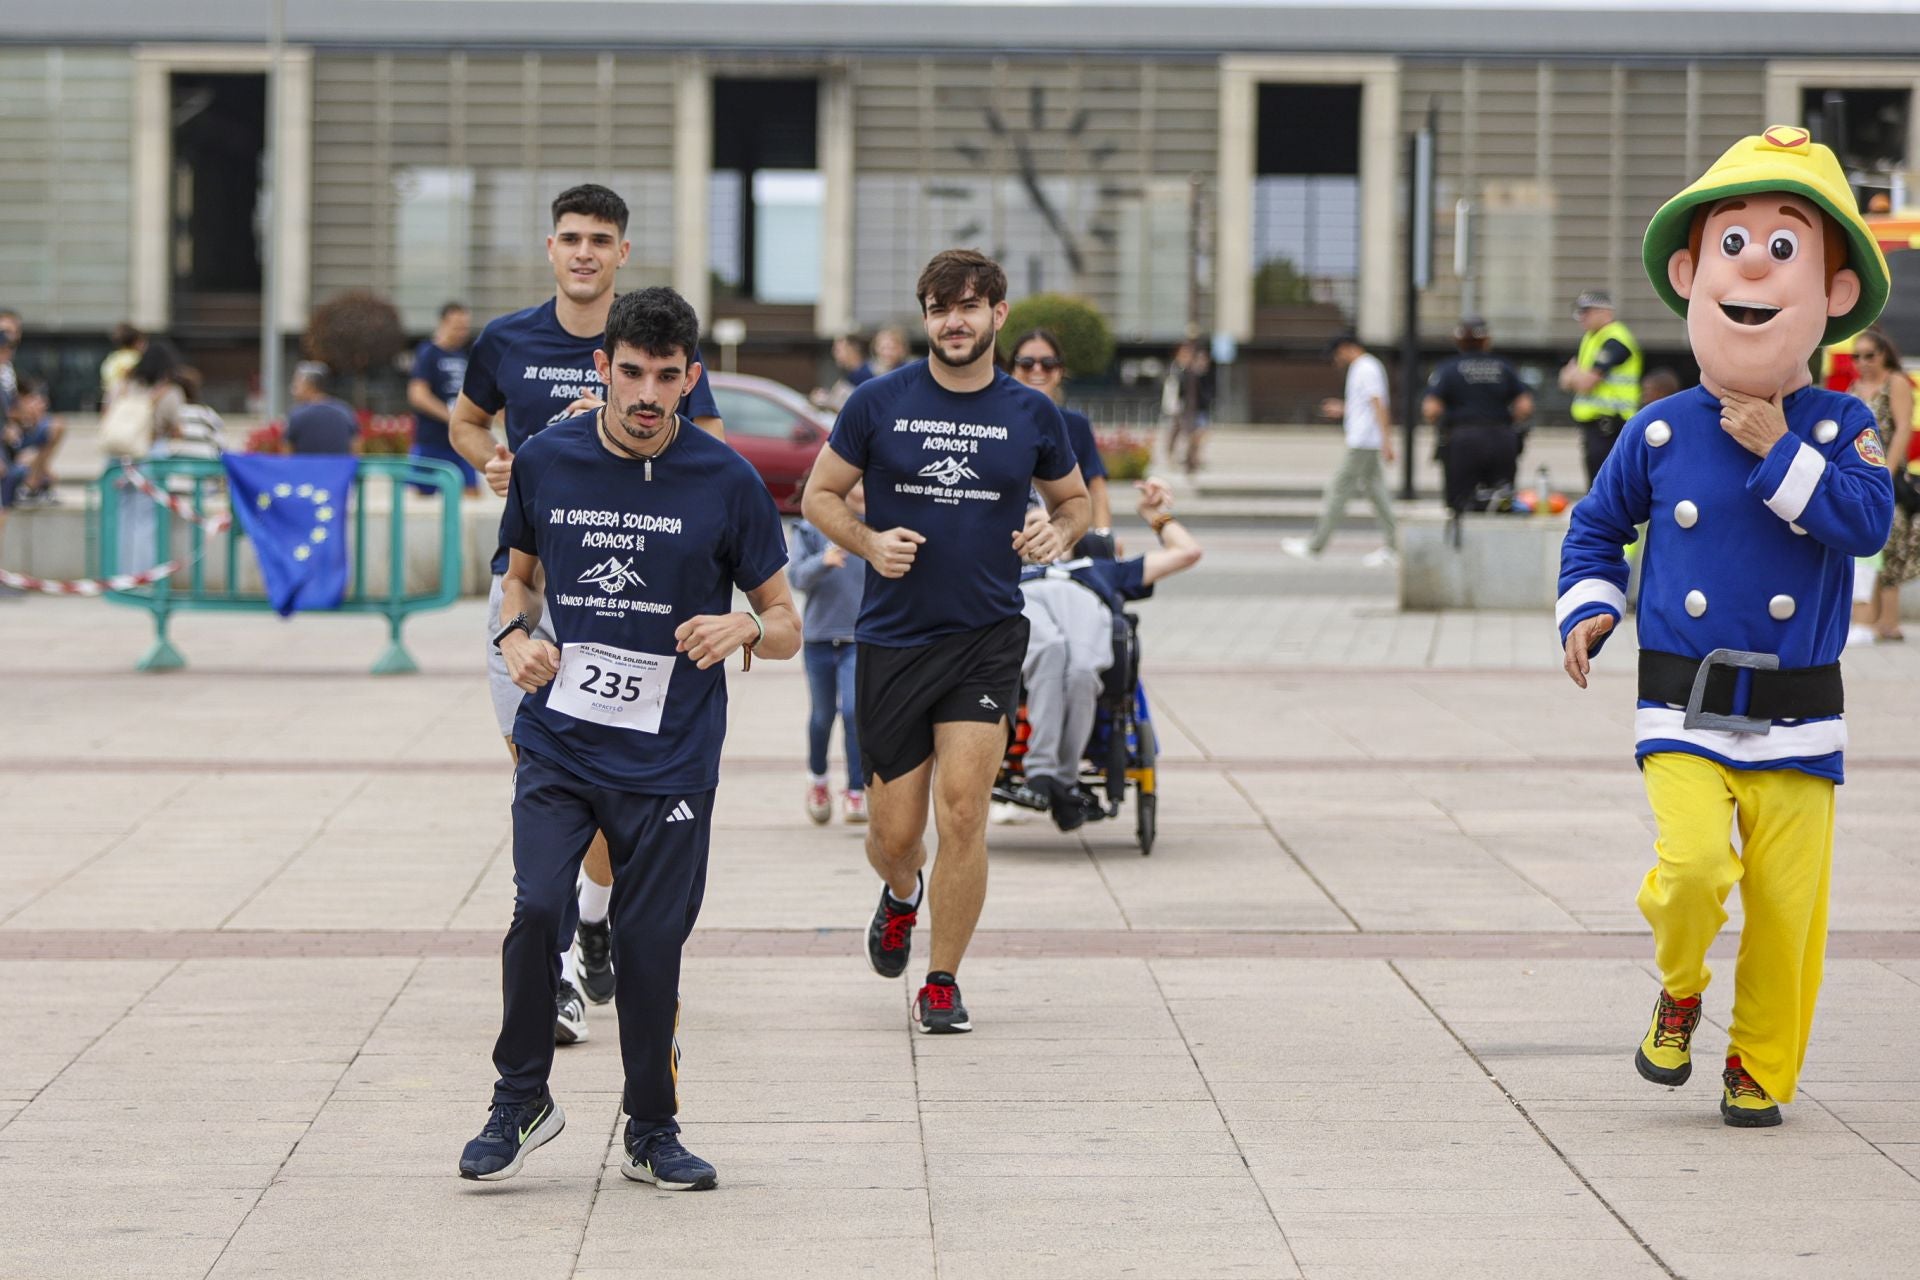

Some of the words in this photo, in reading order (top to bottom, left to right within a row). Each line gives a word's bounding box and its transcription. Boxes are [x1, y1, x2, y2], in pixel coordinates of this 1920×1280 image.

[523, 366, 538, 379] XII
[539, 367, 583, 382] CARRERA
[550, 384, 595, 399] ACPAC
[893, 419, 908, 432] XII
[910, 420, 956, 435] CARRERA
[958, 423, 1008, 440] SOLIDARIA
[922, 436, 968, 453] ACPACYS
[944, 487, 953, 497] ES
[953, 489, 964, 498] NO
[550, 508, 564, 524] XII
[567, 509, 620, 527] CARRERA
[623, 513, 682, 534] SOLIDARIA
[582, 531, 634, 550] ACPACYS
[561, 593, 584, 607] ÚNICO
[585, 595, 607, 608] LÍMITE
[608, 598, 617, 609] ES
[618, 599, 630, 610] NO
[631, 602, 671, 614] INTENTARLO
[591, 647, 621, 660] CARRERA
[623, 656, 658, 666] SOLIDARIA
[579, 665, 642, 702] 235
